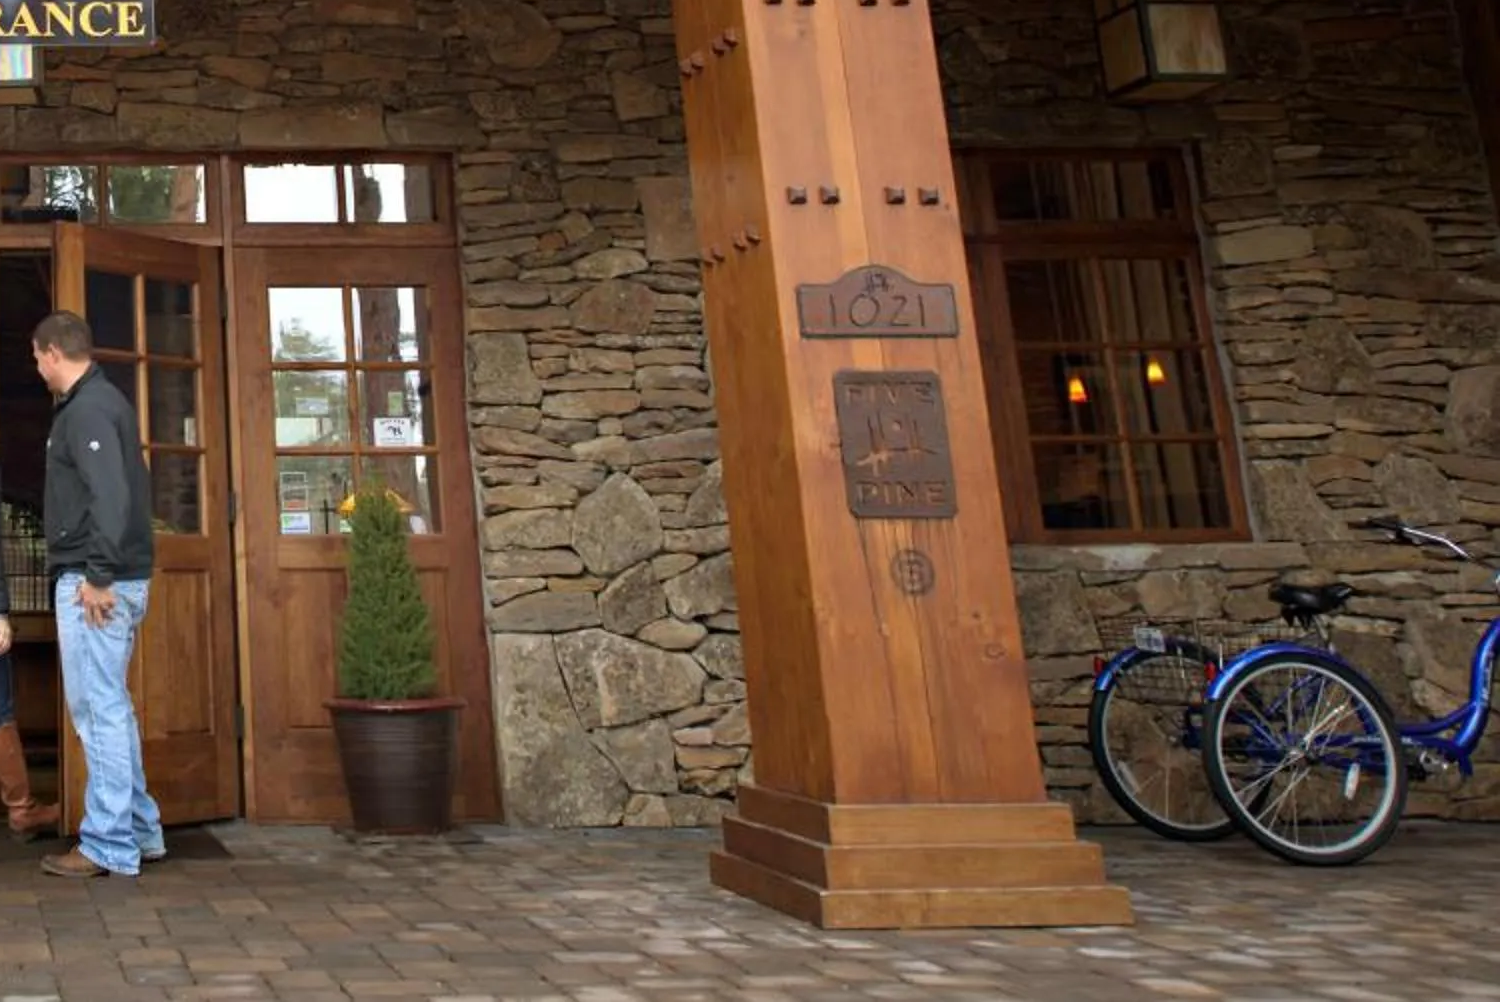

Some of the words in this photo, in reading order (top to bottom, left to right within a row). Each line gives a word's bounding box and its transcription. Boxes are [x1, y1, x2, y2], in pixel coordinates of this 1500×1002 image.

[829, 292, 926, 328] 1021
[842, 381, 935, 406] FIVE
[854, 480, 947, 506] PINE
